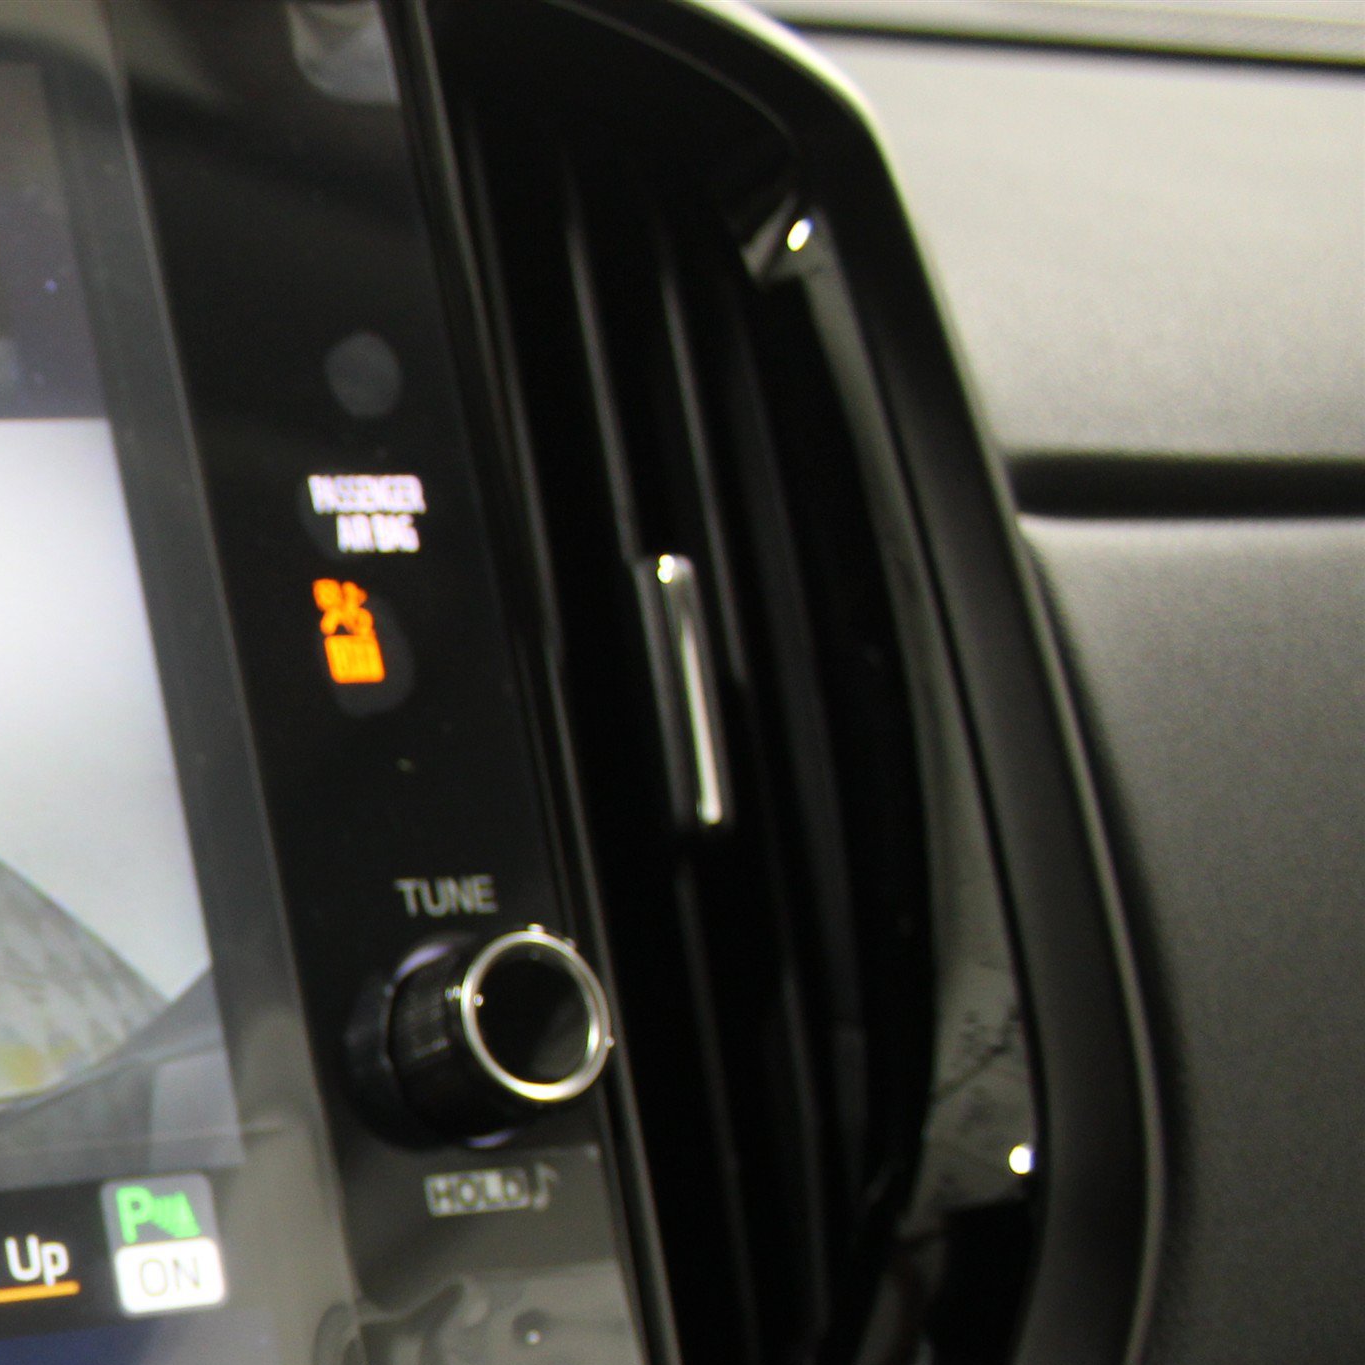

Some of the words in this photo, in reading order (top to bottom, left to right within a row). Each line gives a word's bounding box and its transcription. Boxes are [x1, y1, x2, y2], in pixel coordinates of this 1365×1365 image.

[397, 876, 495, 916] TUNE
[4, 1234, 69, 1285] Up
[139, 1256, 201, 1298] ON
